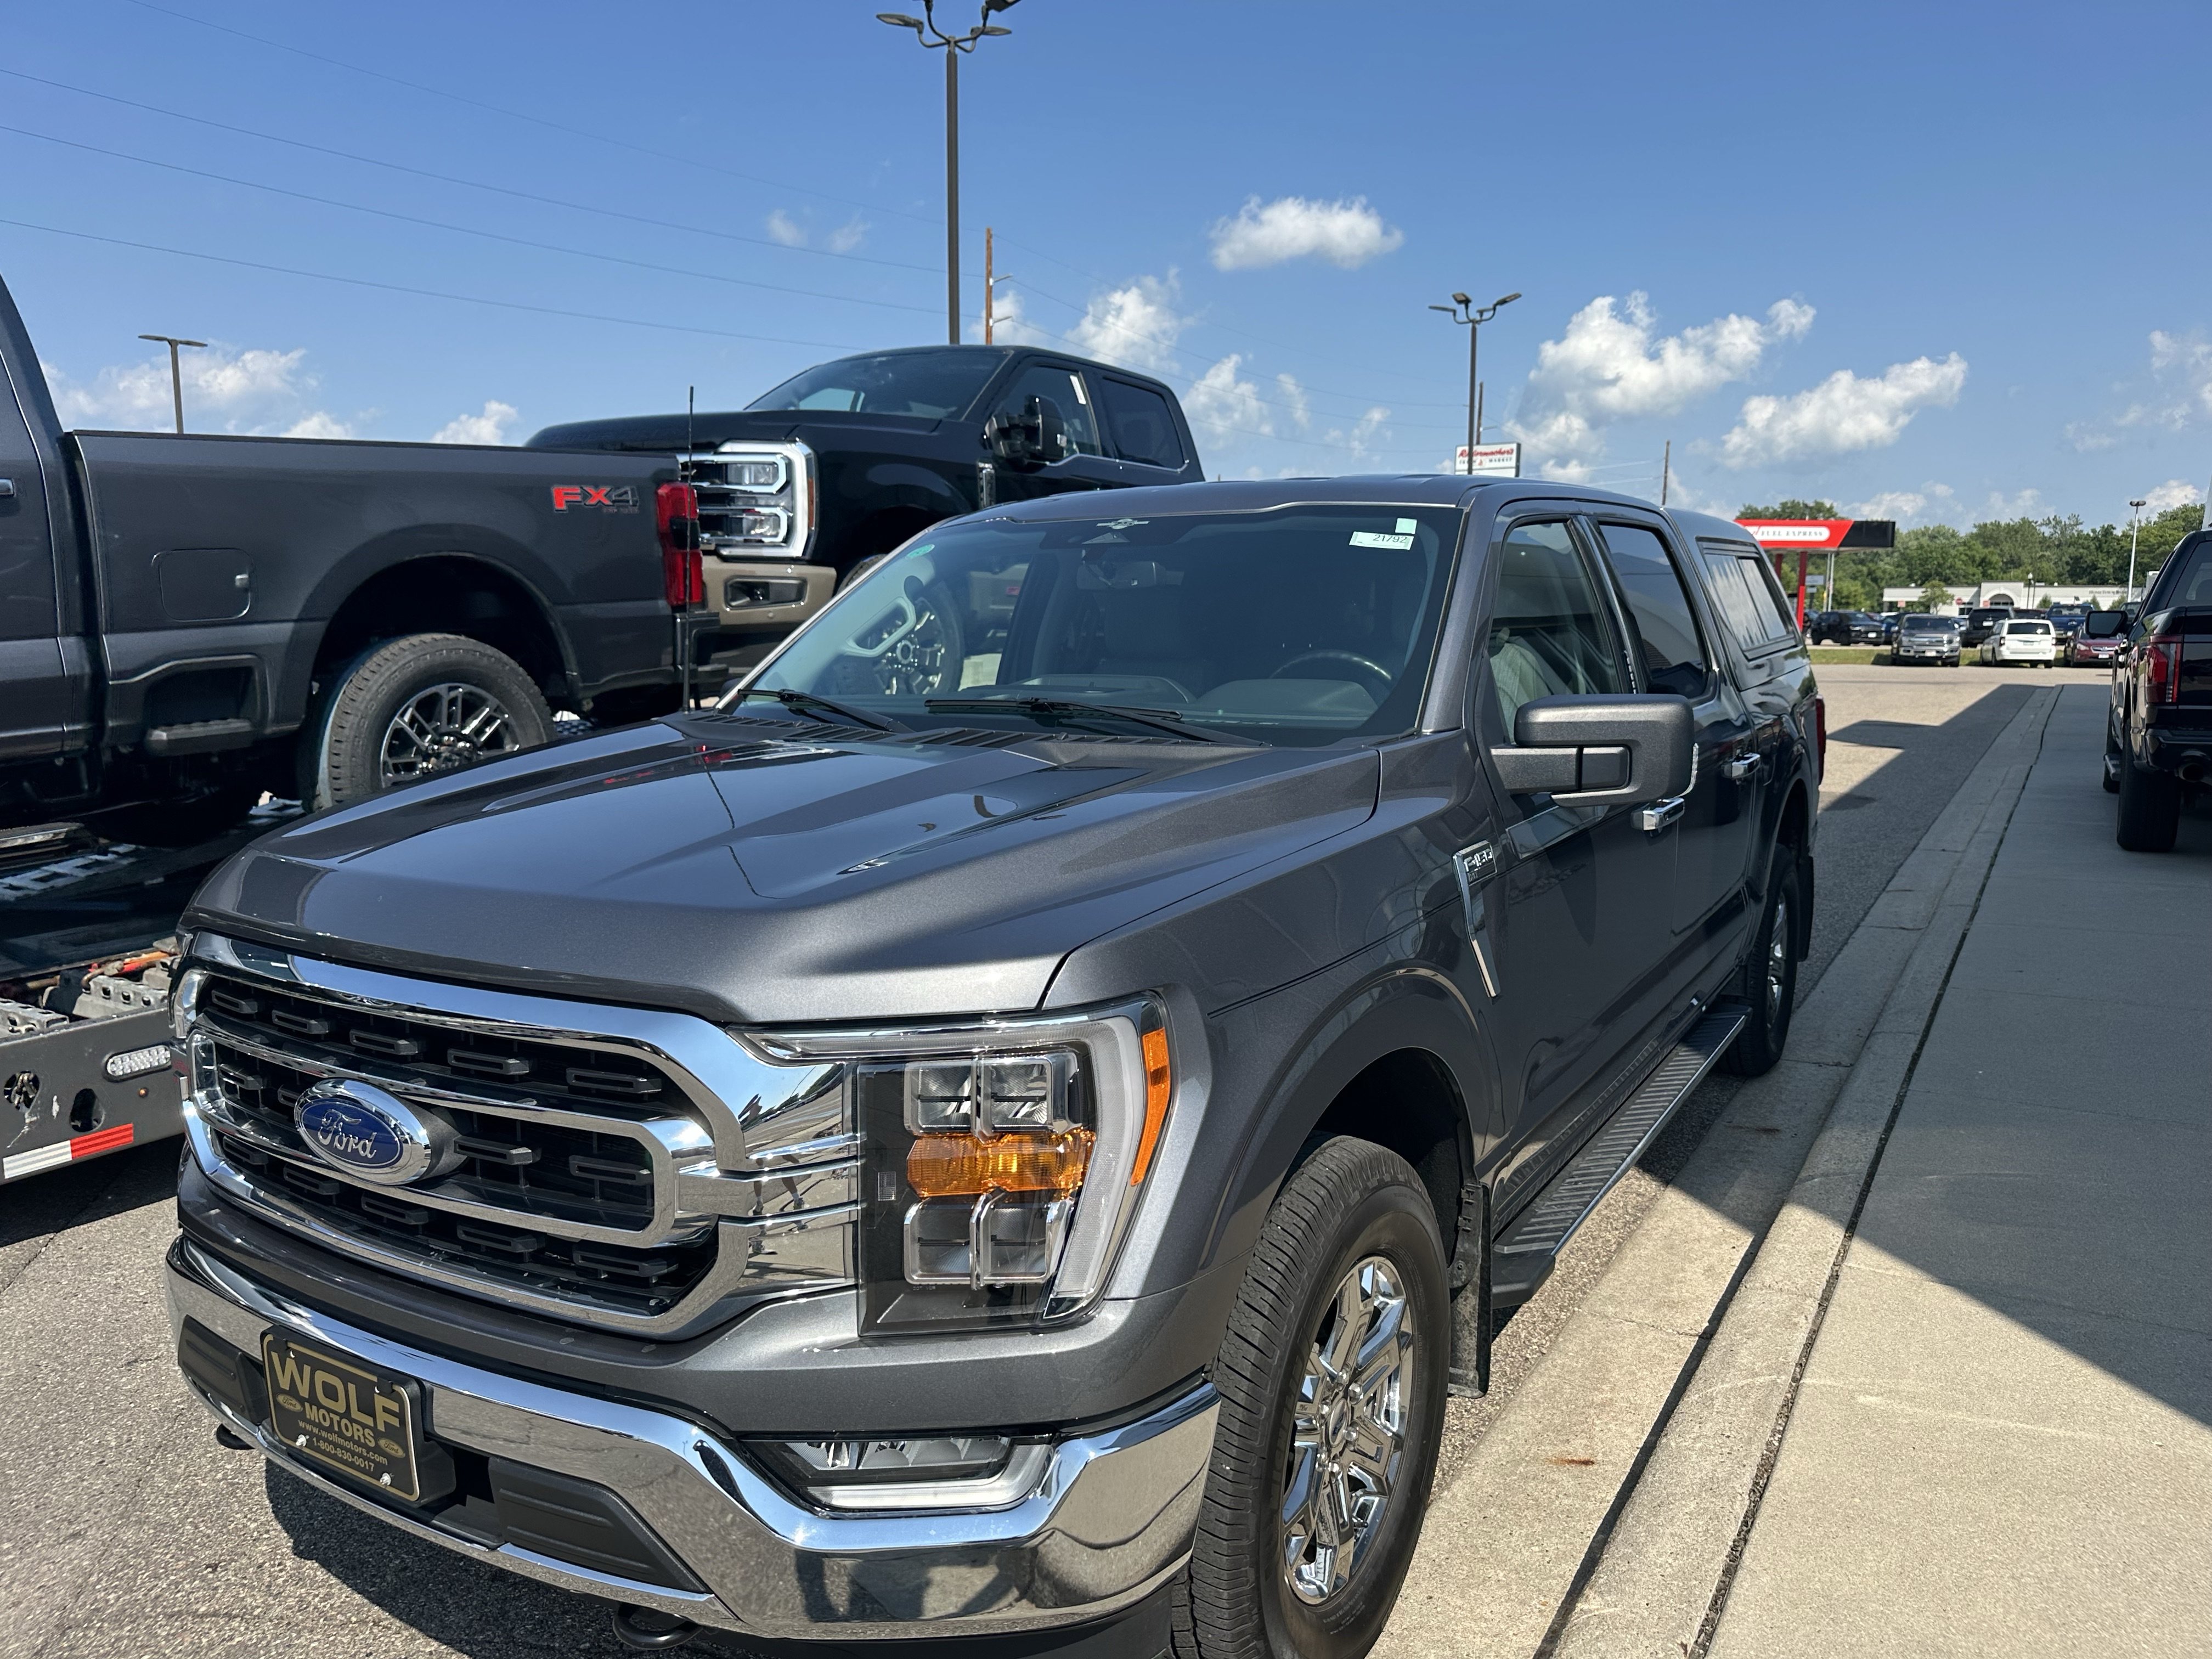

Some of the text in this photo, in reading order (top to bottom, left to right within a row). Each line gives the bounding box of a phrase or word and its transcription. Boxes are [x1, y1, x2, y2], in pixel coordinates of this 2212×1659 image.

[552, 486, 639, 512] FX4
[1373, 534, 1407, 543] 21792
[317, 1109, 377, 1158] Ford
[270, 1351, 400, 1432] WOLF
[298, 1419, 388, 1466] www.wolfmotors.com
[305, 1401, 376, 1447] MOTORS
[312, 1437, 375, 1472] 1-800-830-0017
